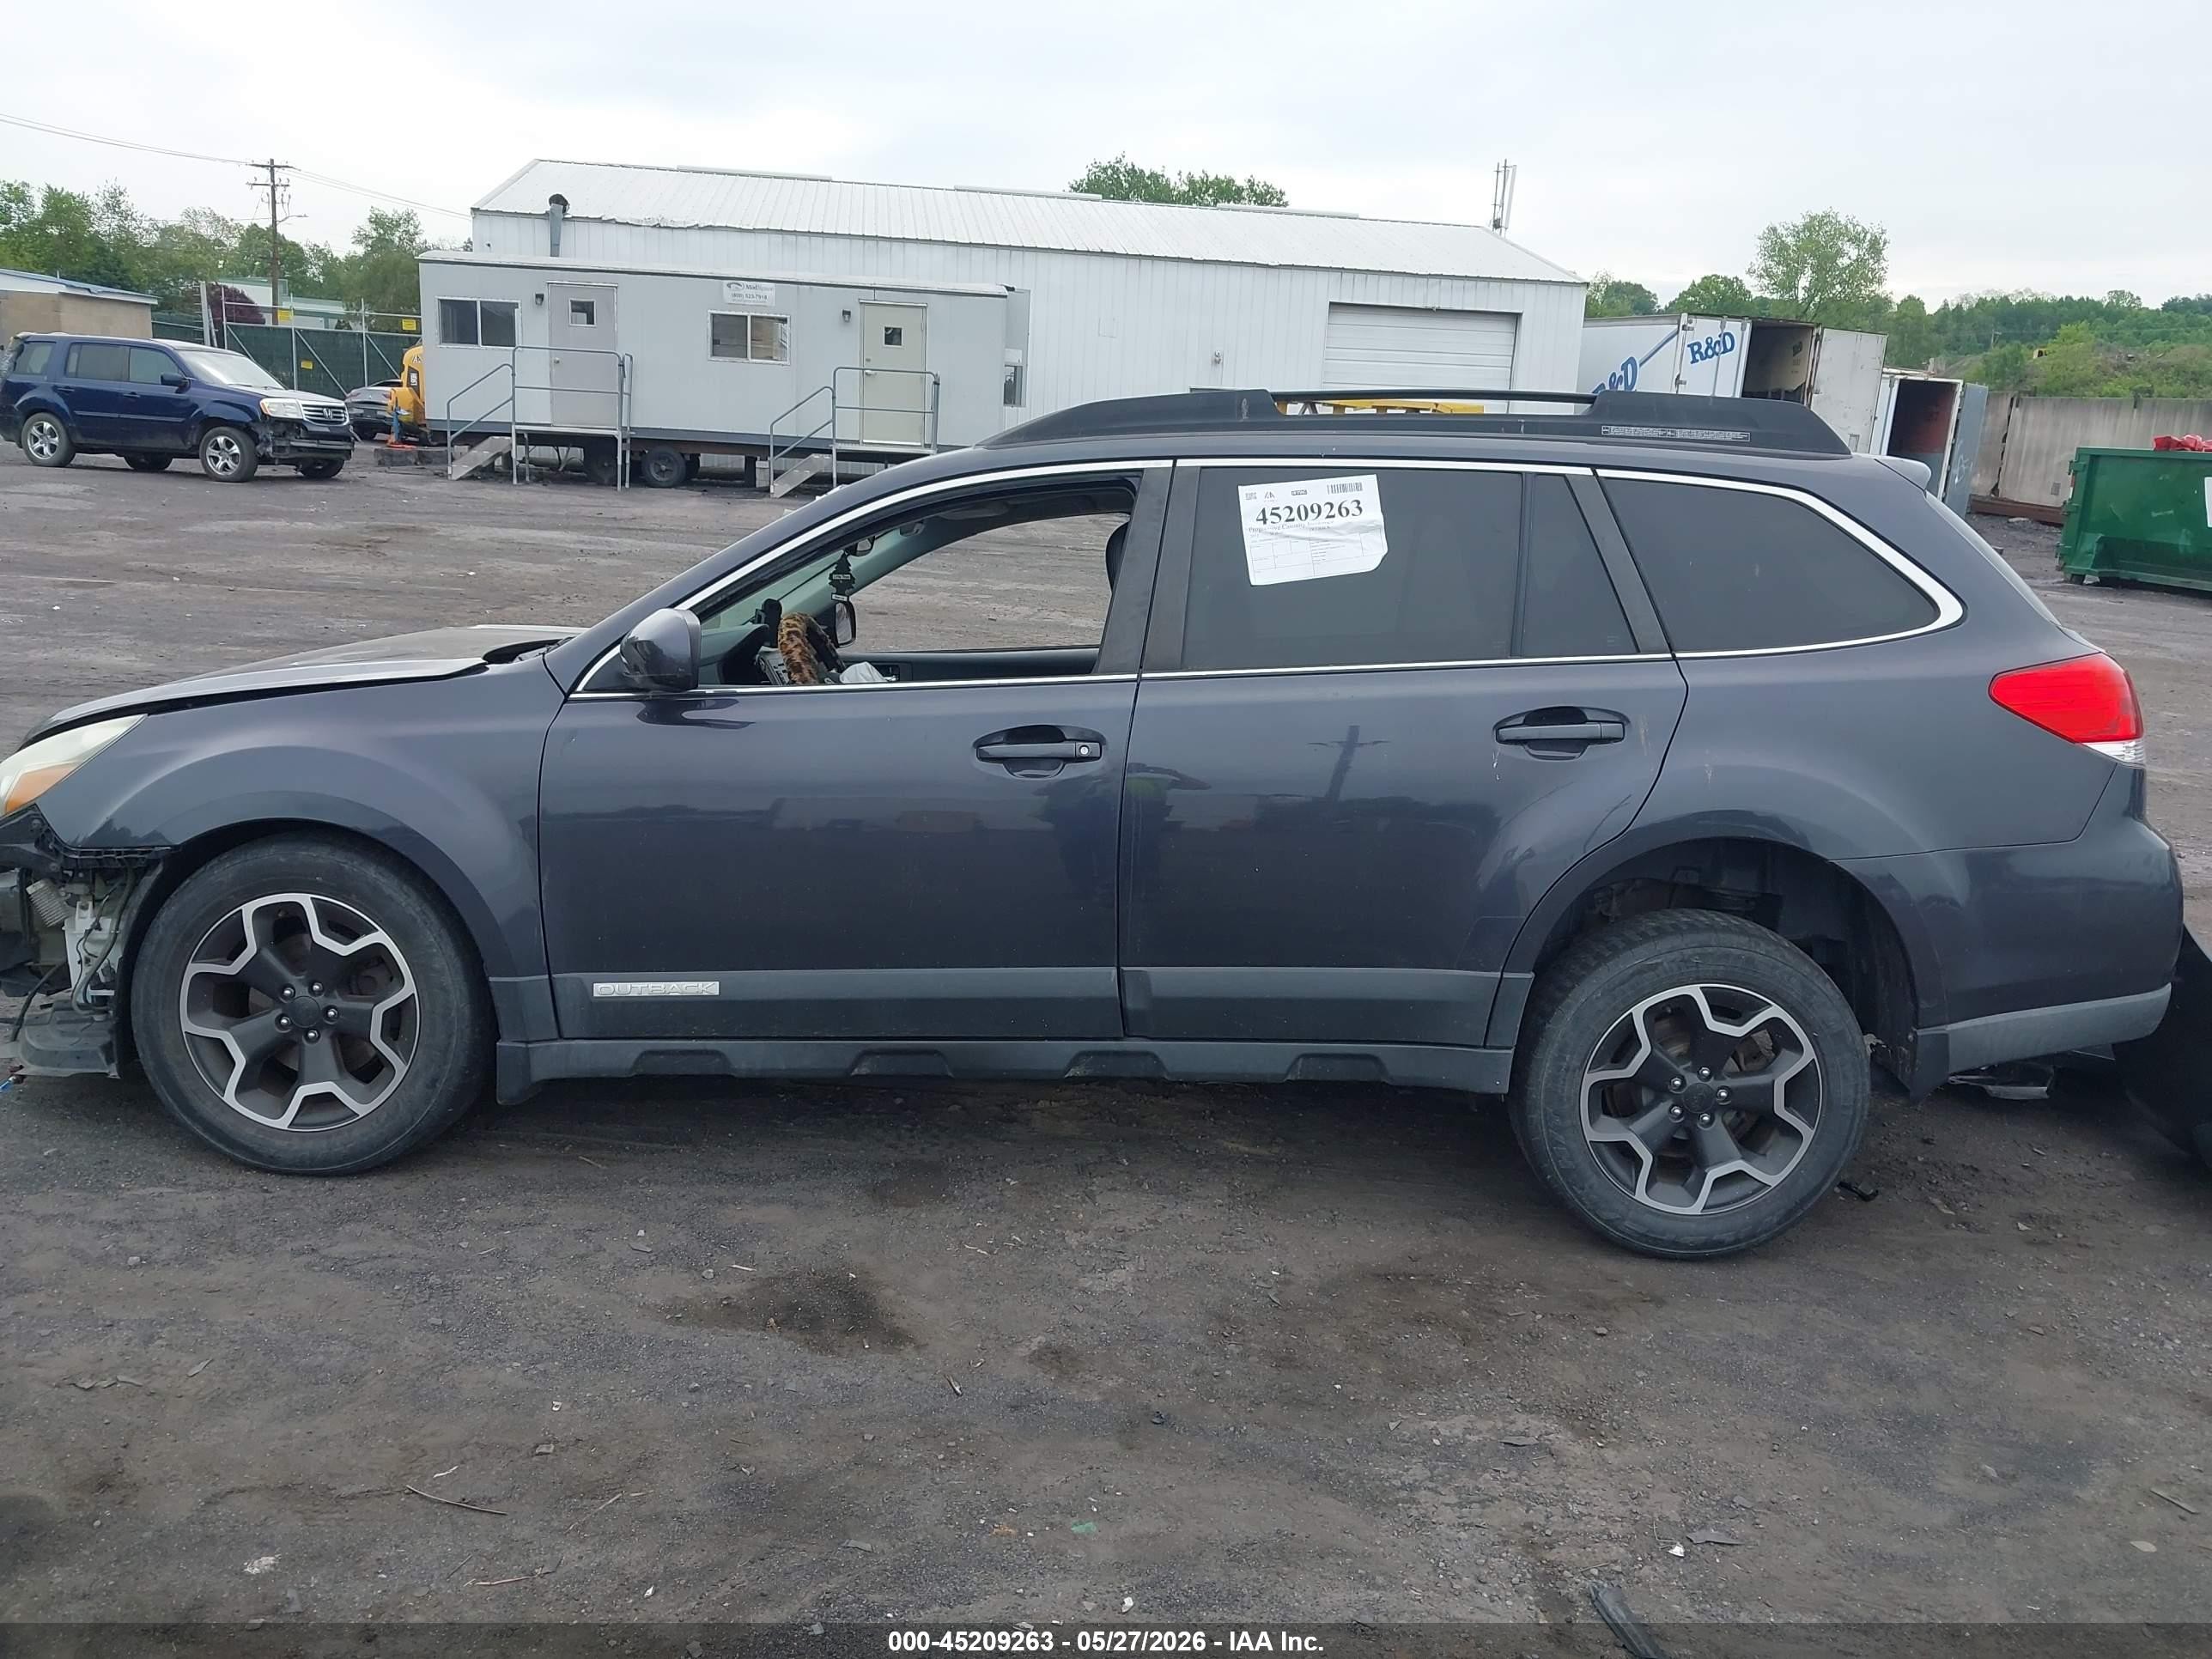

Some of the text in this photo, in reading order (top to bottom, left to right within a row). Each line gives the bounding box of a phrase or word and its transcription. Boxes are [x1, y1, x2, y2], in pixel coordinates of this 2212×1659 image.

[1687, 331, 1735, 364] R&D
[1255, 499, 1364, 525] 45209263
[598, 982, 715, 996] OUTBACK
